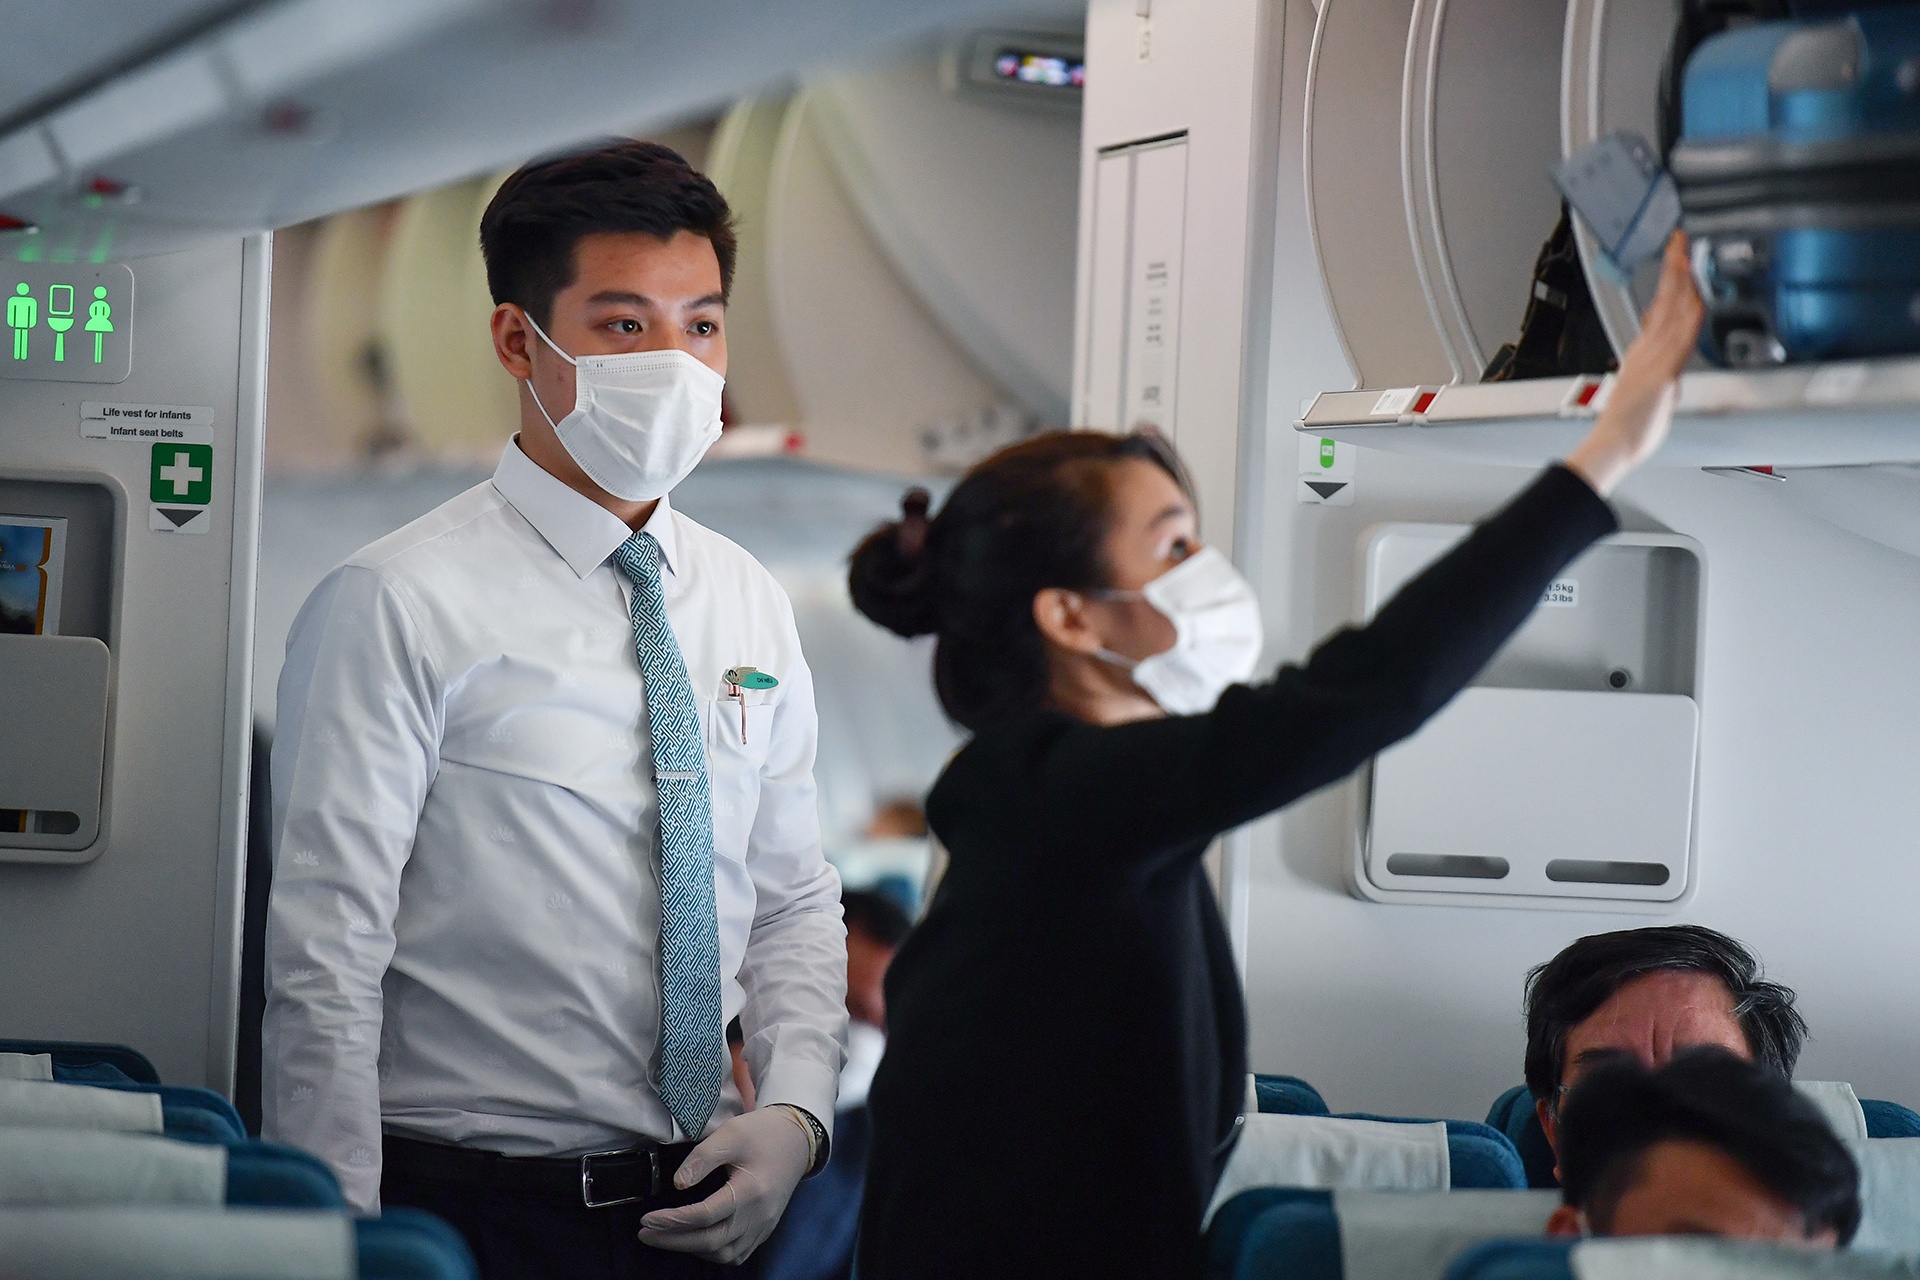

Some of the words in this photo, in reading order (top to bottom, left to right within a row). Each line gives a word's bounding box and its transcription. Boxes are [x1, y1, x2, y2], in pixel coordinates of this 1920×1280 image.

[103, 407, 120, 417] Life
[122, 409, 142, 418] vest
[144, 409, 157, 418] for
[160, 410, 192, 420] infants
[110, 426, 137, 436] Infant
[139, 428, 159, 437] seat
[161, 429, 184, 438] belts
